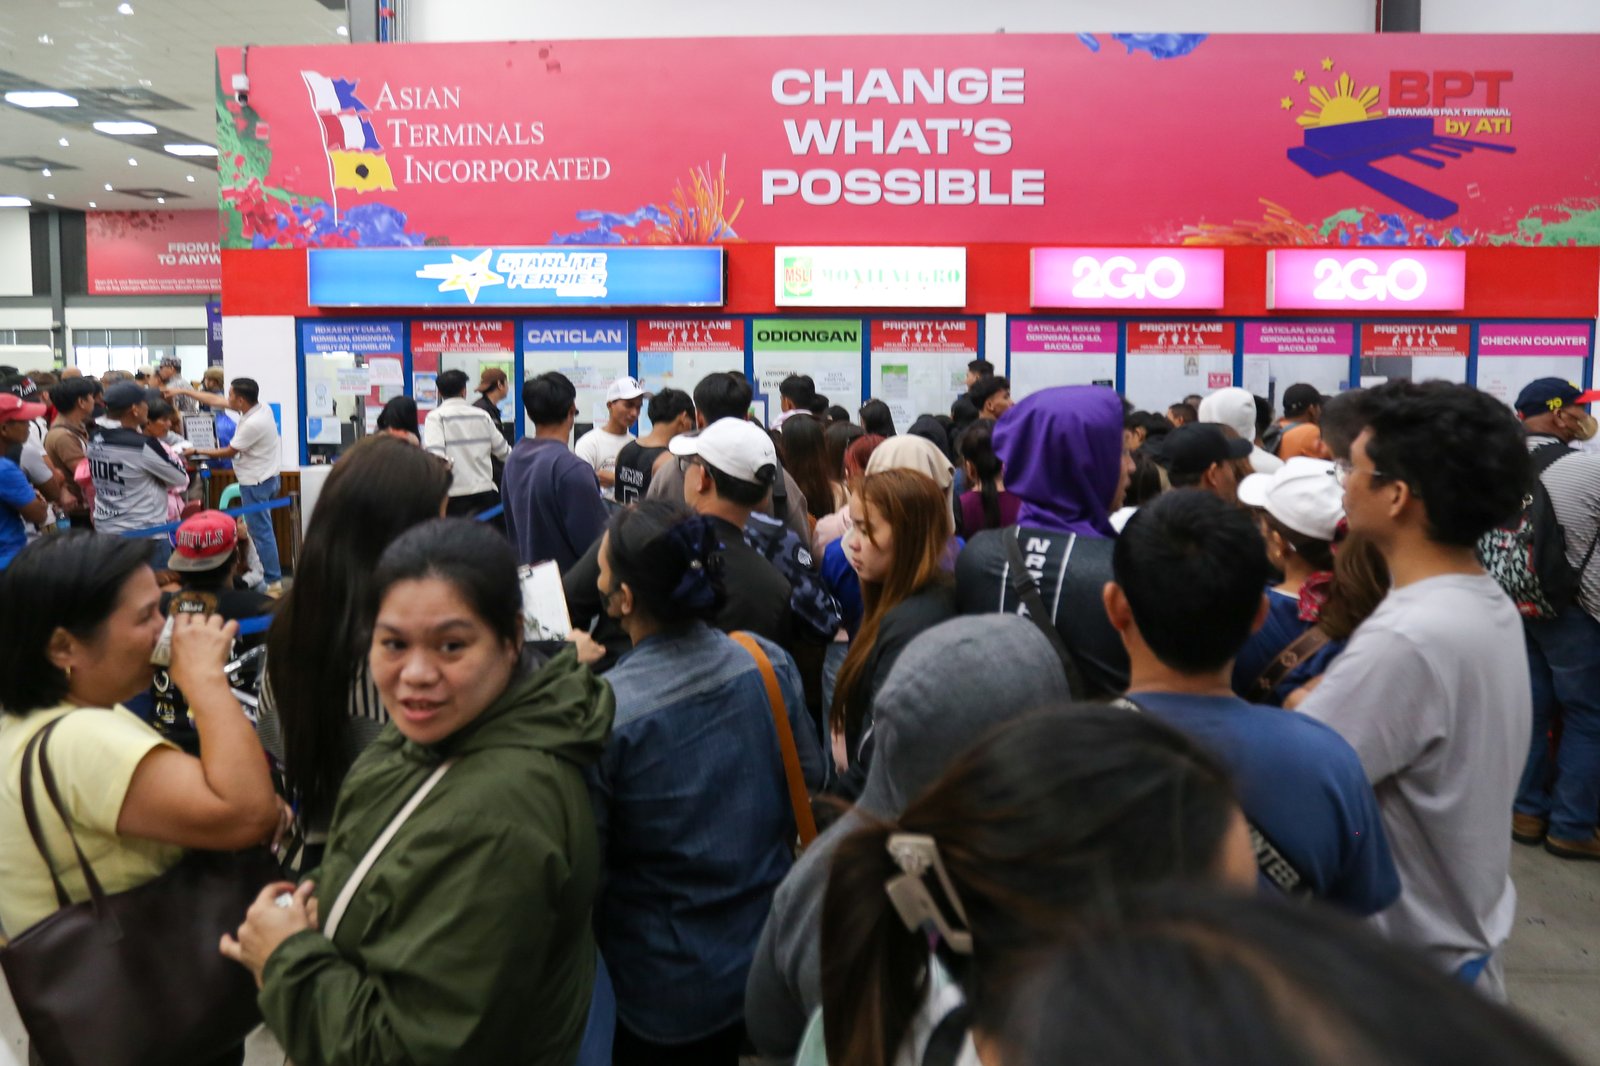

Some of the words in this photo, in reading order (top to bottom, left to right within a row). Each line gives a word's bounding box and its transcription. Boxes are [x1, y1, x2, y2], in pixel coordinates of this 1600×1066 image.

[771, 68, 1025, 105] CHANGE
[1388, 70, 1513, 108] BPT
[374, 81, 462, 111] ASIAN
[1441, 108, 1461, 116] PAX
[1463, 108, 1511, 116] TERMINAL
[386, 118, 544, 148] TERMINALS
[1445, 118, 1471, 137] by
[1475, 118, 1512, 134] ATI
[783, 118, 1013, 156] WHAT'S
[403, 154, 611, 184] INCORPORATED
[762, 168, 1046, 206] POSSIBLE
[168, 242, 209, 253] FROM
[158, 254, 178, 265] TO
[1071, 255, 1186, 300] 2GO
[1313, 257, 1428, 302] 2GO
[422, 322, 471, 331] PRIORITY
[473, 322, 502, 331] LANE
[649, 320, 699, 330] PRIORITY
[702, 320, 731, 330] LANE
[882, 320, 934, 330] PRIORITY
[936, 320, 966, 330] LANE
[1139, 323, 1189, 333] PRIORITY
[1192, 323, 1223, 333] LANE
[1373, 325, 1424, 335] PRIORITY
[1426, 325, 1457, 335] LANE
[527, 329, 622, 345] CATICLAN
[757, 329, 857, 343] ODIONGAN
[1481, 336, 1532, 346] CHECK-IN
[1533, 336, 1587, 346] COUNTER
